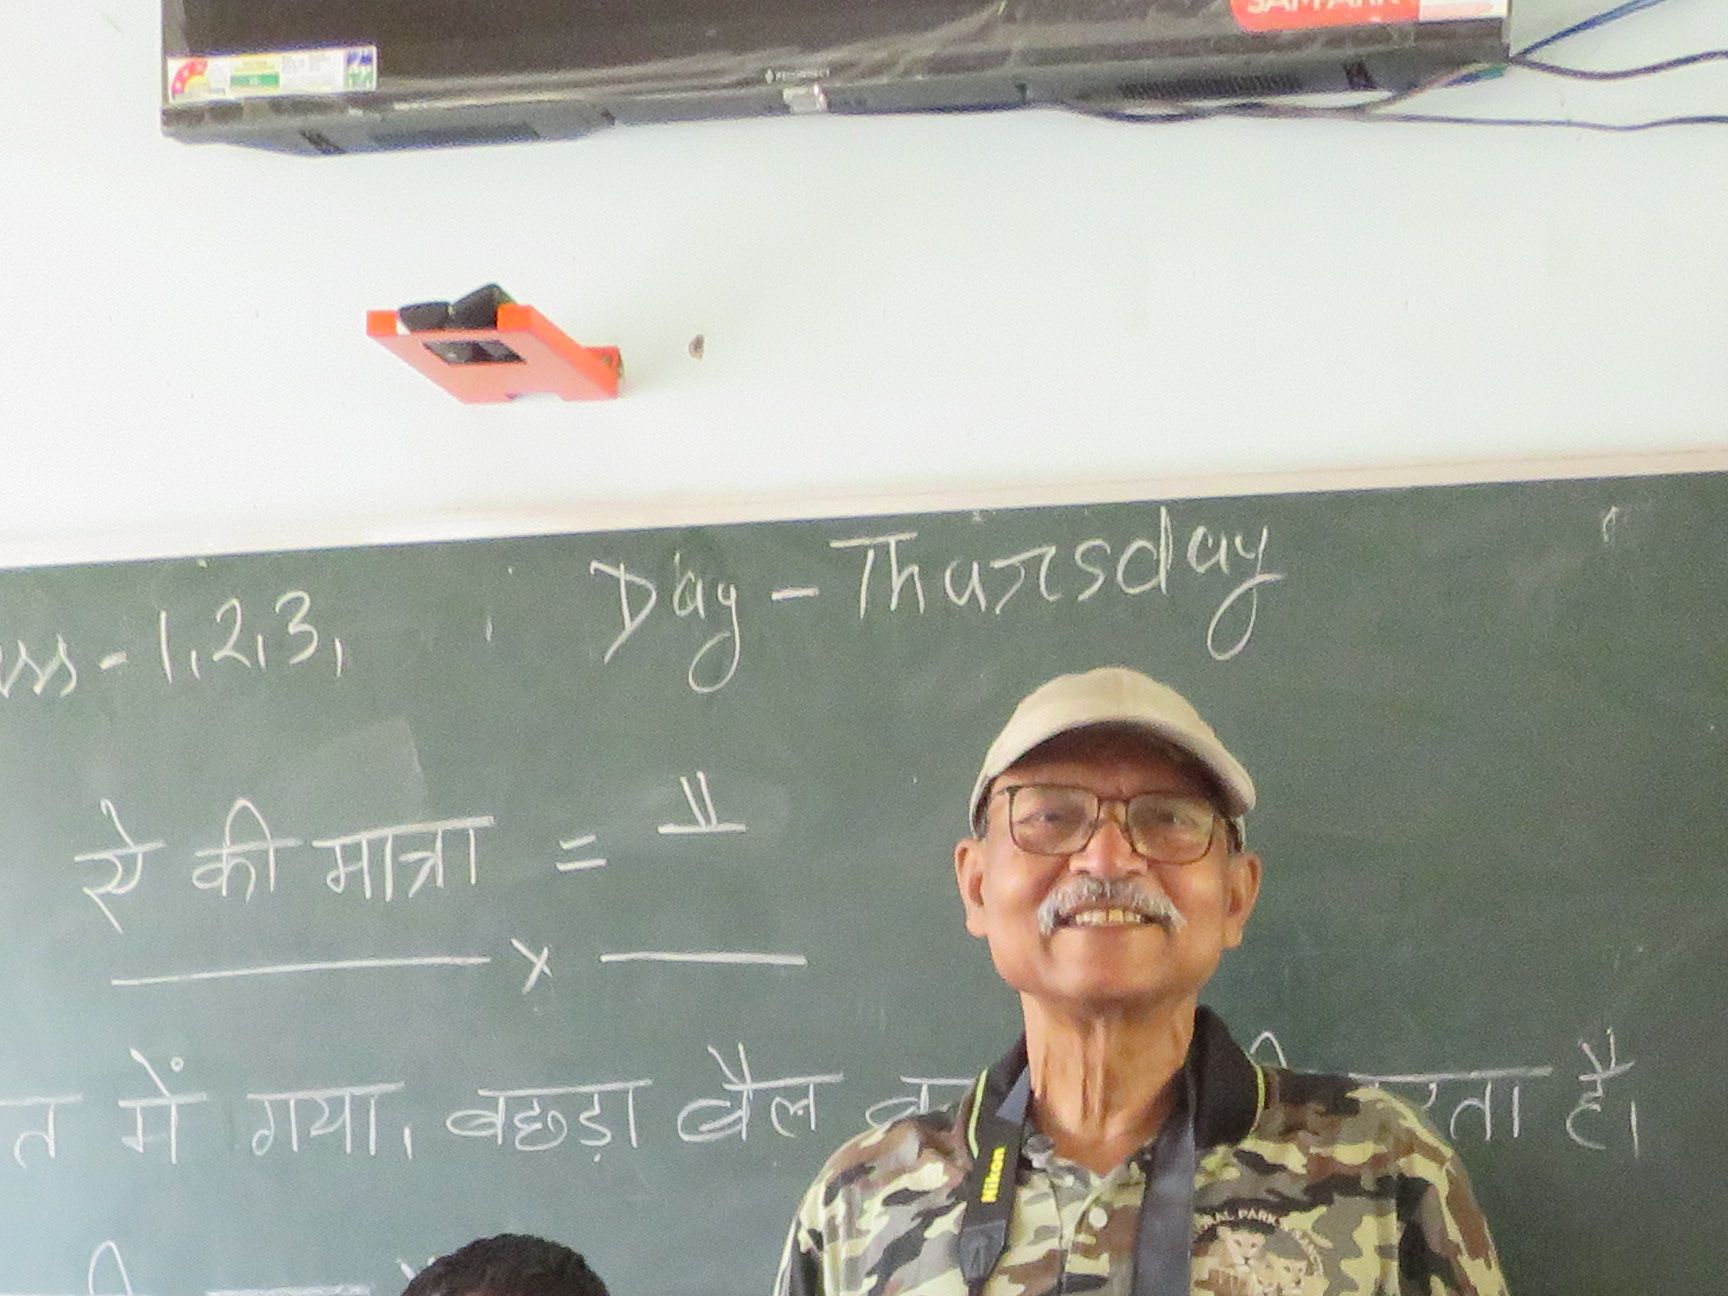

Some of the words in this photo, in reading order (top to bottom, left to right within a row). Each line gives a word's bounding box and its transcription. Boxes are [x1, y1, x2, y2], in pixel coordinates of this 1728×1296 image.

[192, 797, 304, 903] की
[311, 814, 495, 902] मात्रा
[678, 1042, 844, 1144] बैल
[981, 1146, 1006, 1203] Nikon
